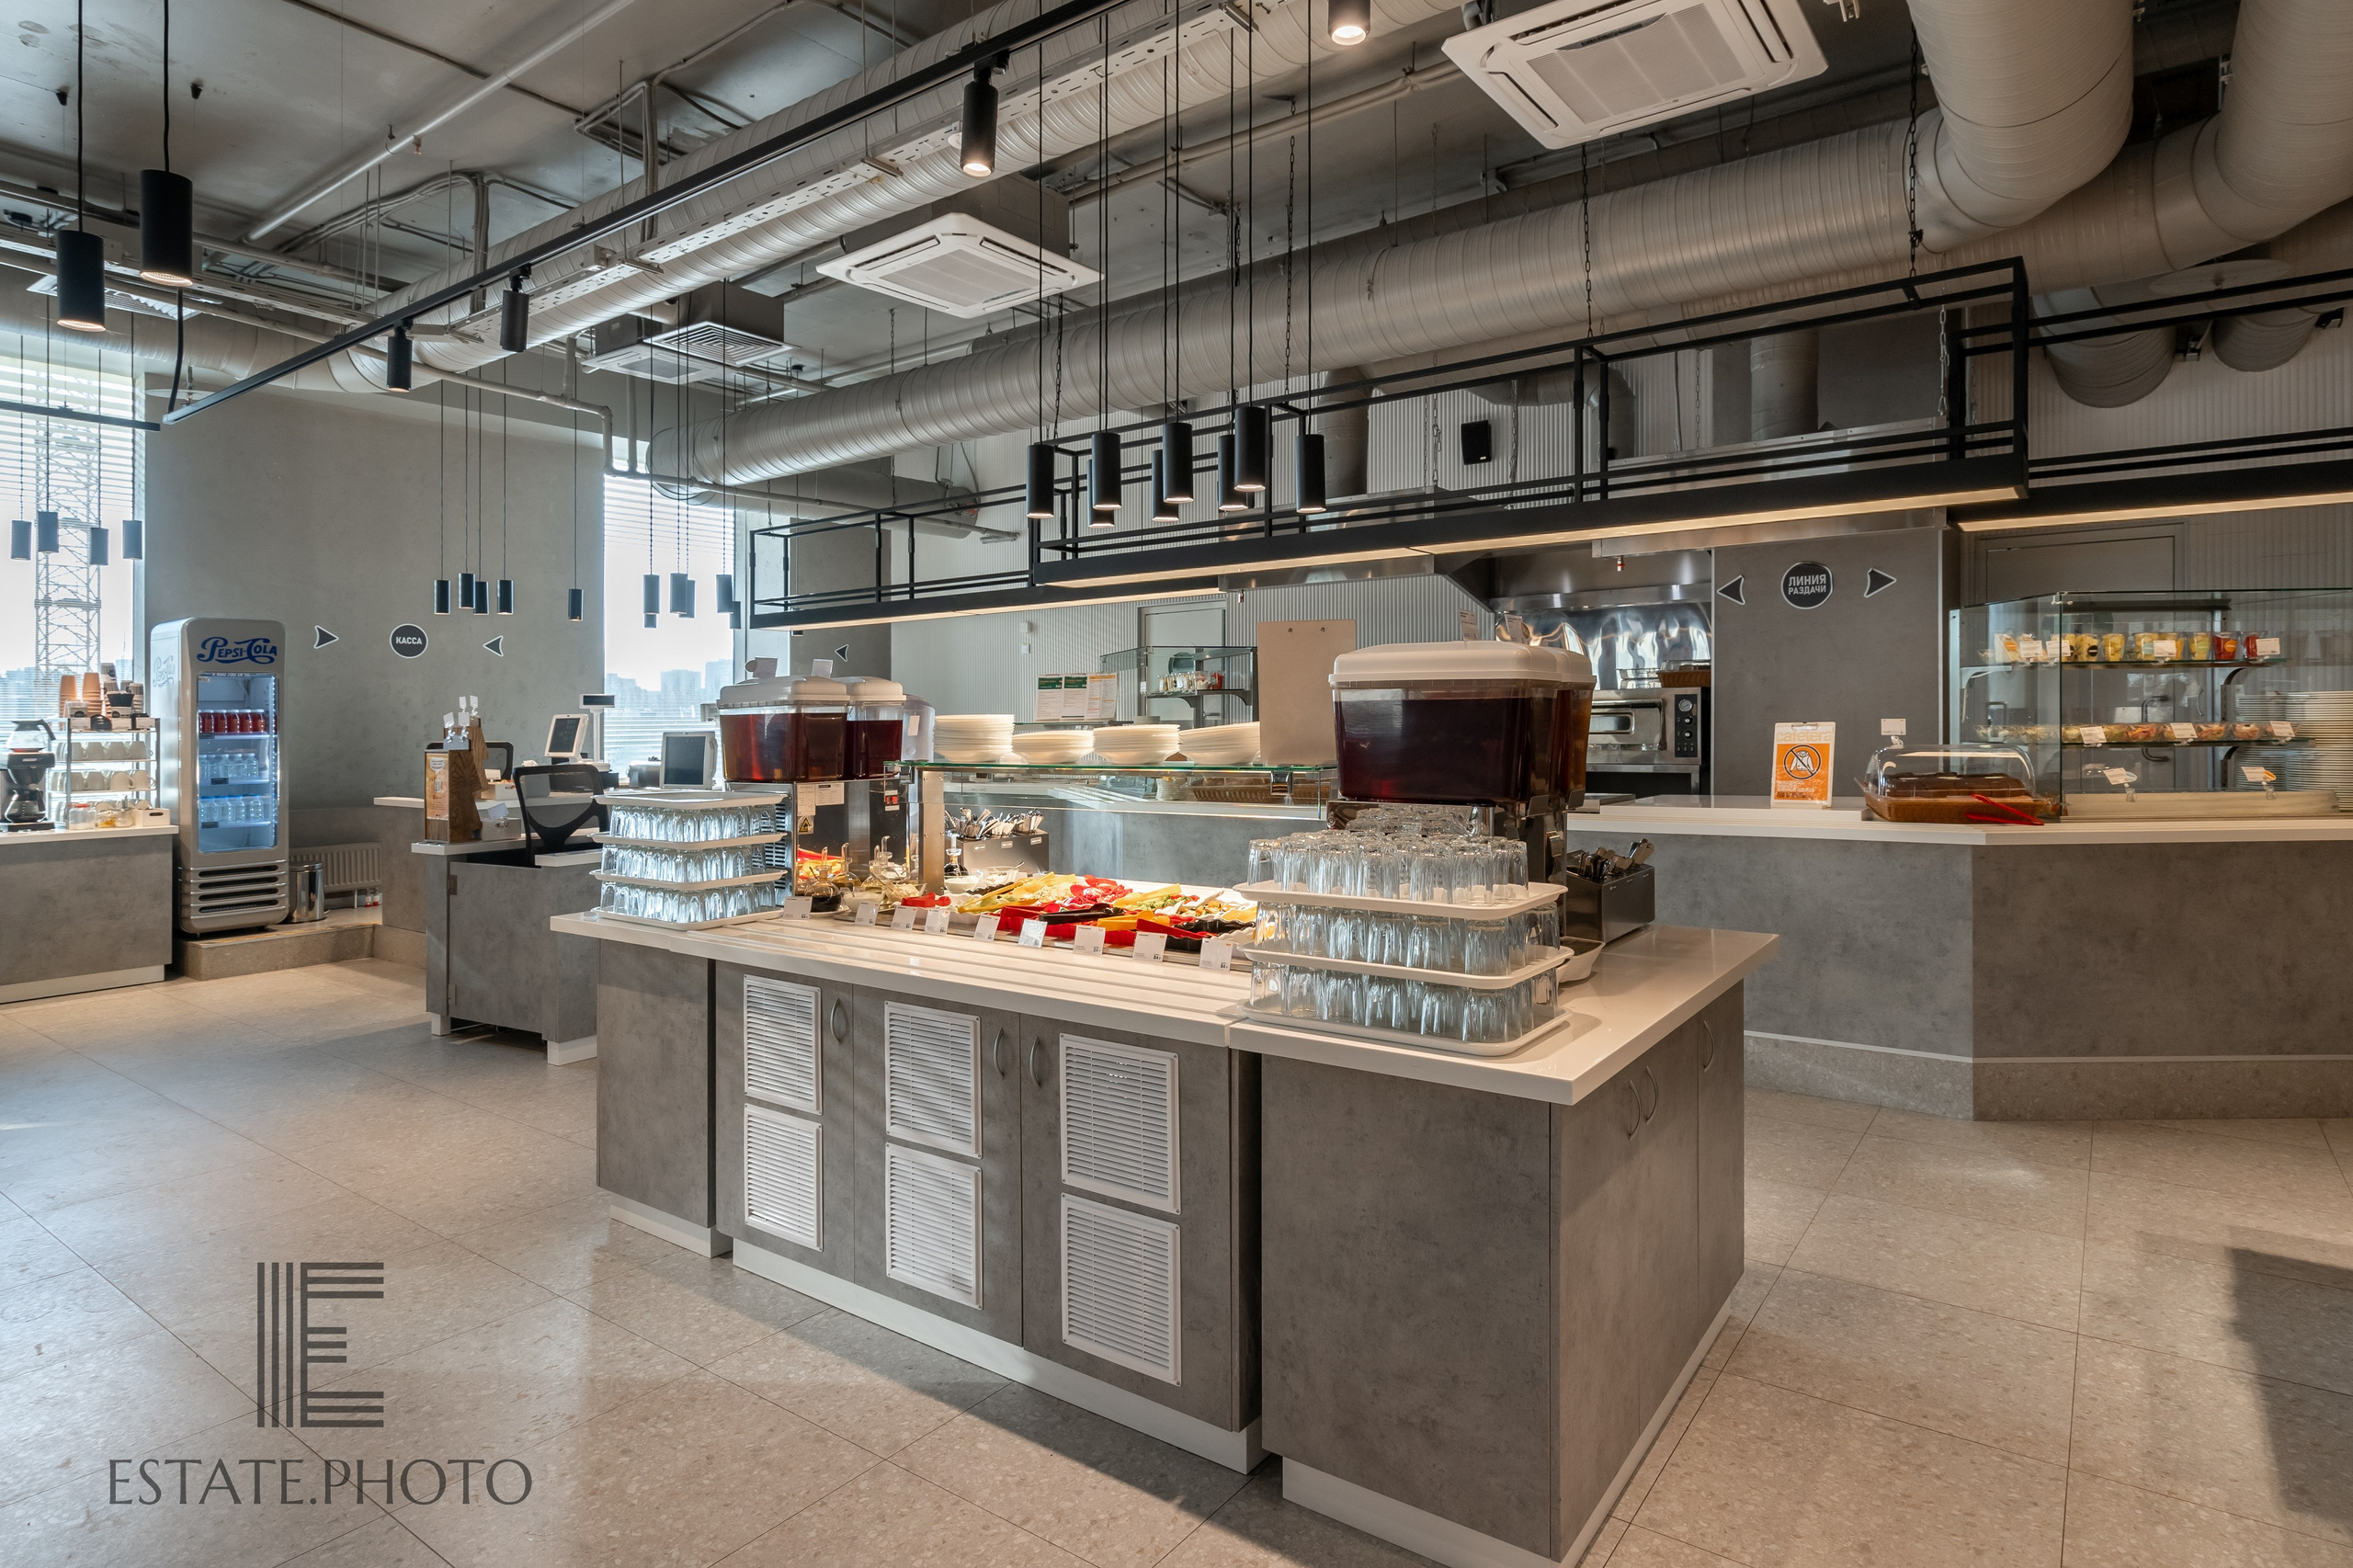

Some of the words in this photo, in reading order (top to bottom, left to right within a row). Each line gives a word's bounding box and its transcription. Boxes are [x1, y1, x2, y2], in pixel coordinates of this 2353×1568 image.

[1789, 574, 1826, 586] ЛИНИЯ
[1788, 585, 1826, 595] РАЗДАЧИ
[395, 636, 423, 644] КАССА
[1776, 730, 1831, 743] cafetera
